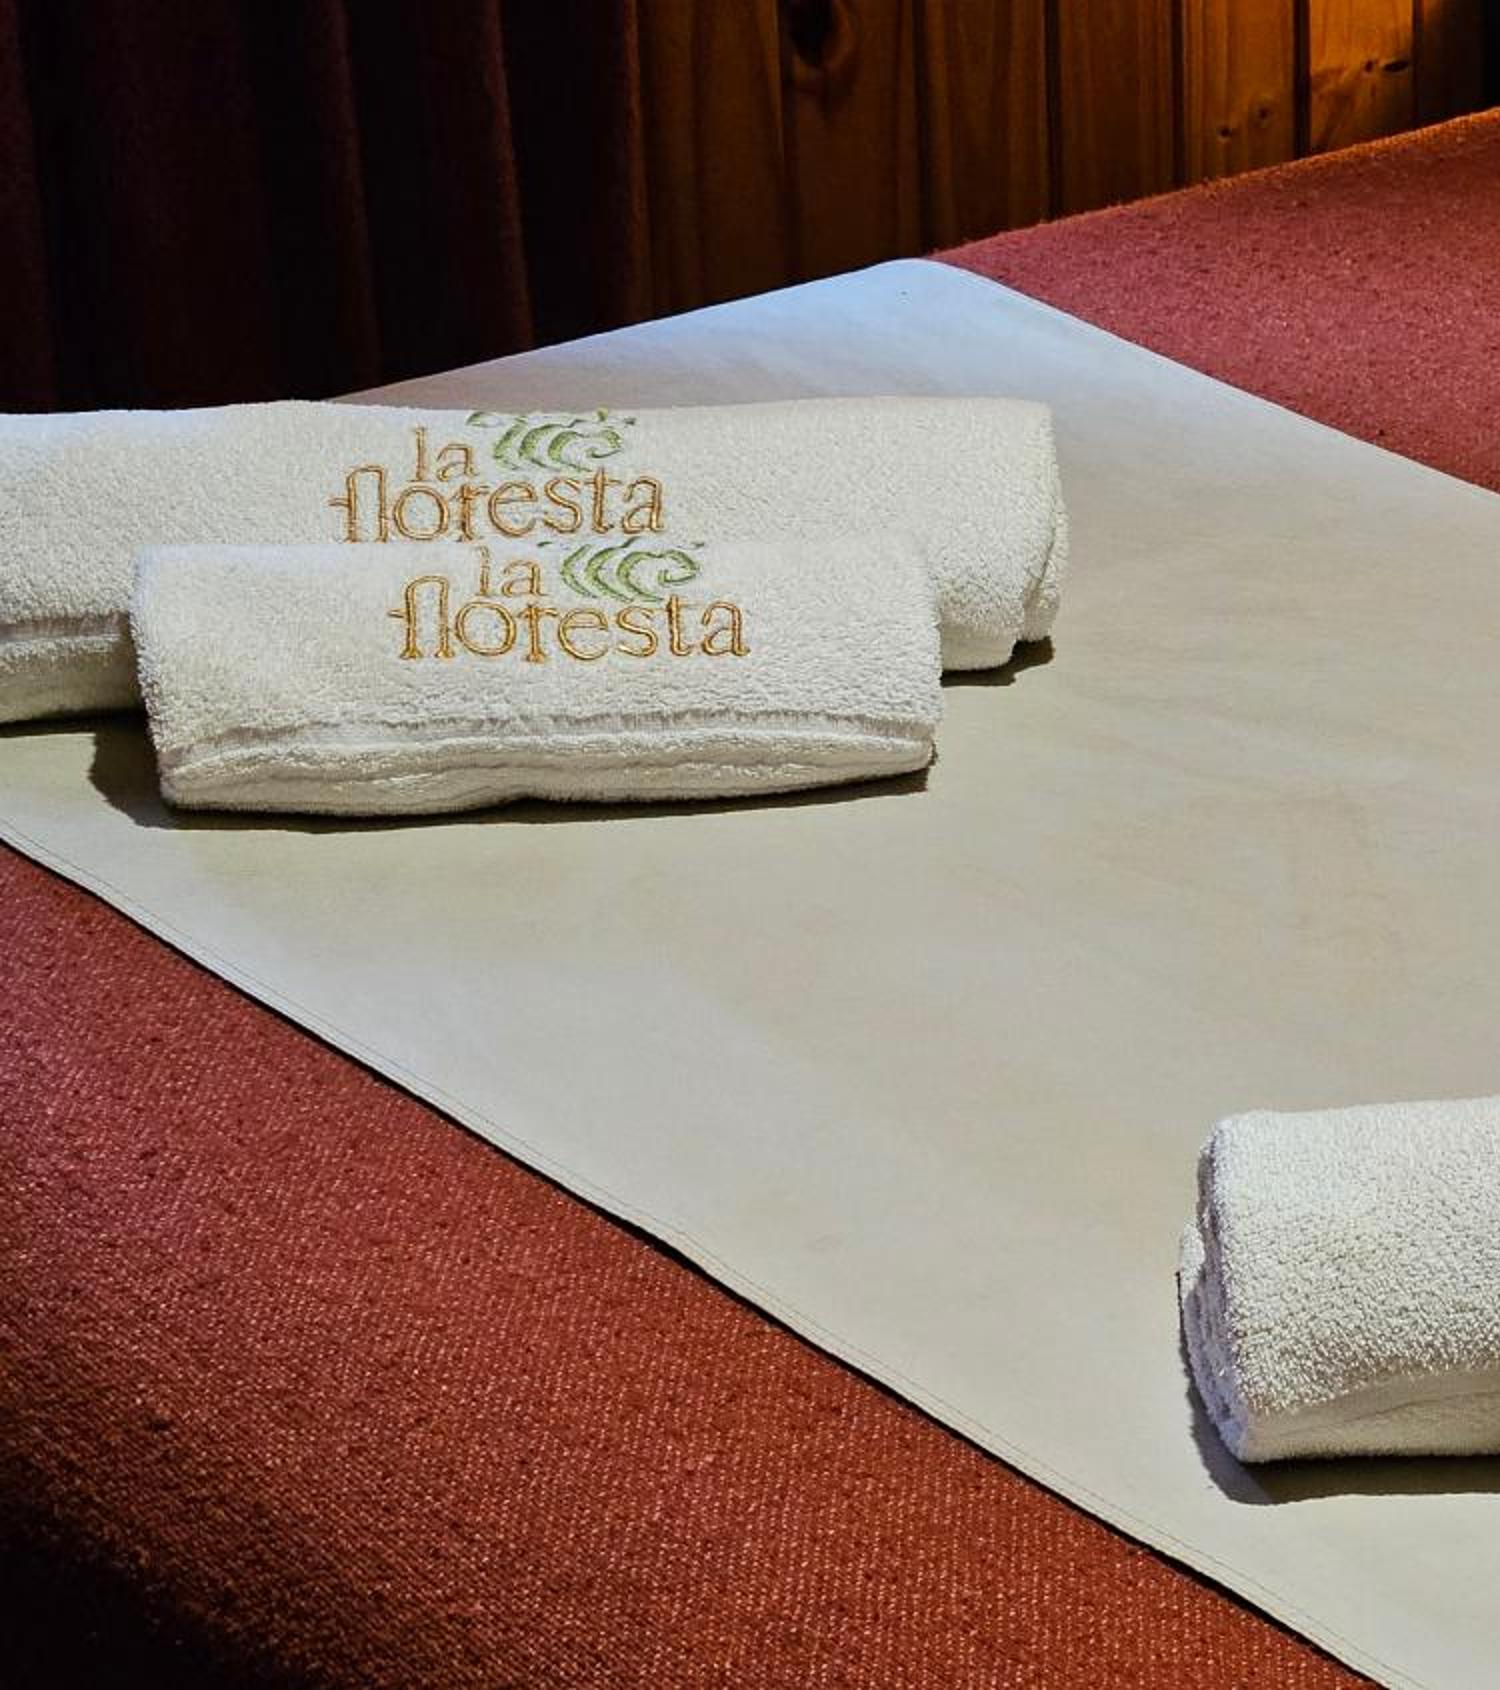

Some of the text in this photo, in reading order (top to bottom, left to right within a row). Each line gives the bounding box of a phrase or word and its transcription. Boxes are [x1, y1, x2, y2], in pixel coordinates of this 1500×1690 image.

[412, 426, 478, 482] la
[329, 464, 665, 542] floresta
[478, 545, 547, 597] la
[388, 575, 751, 662] floresta
